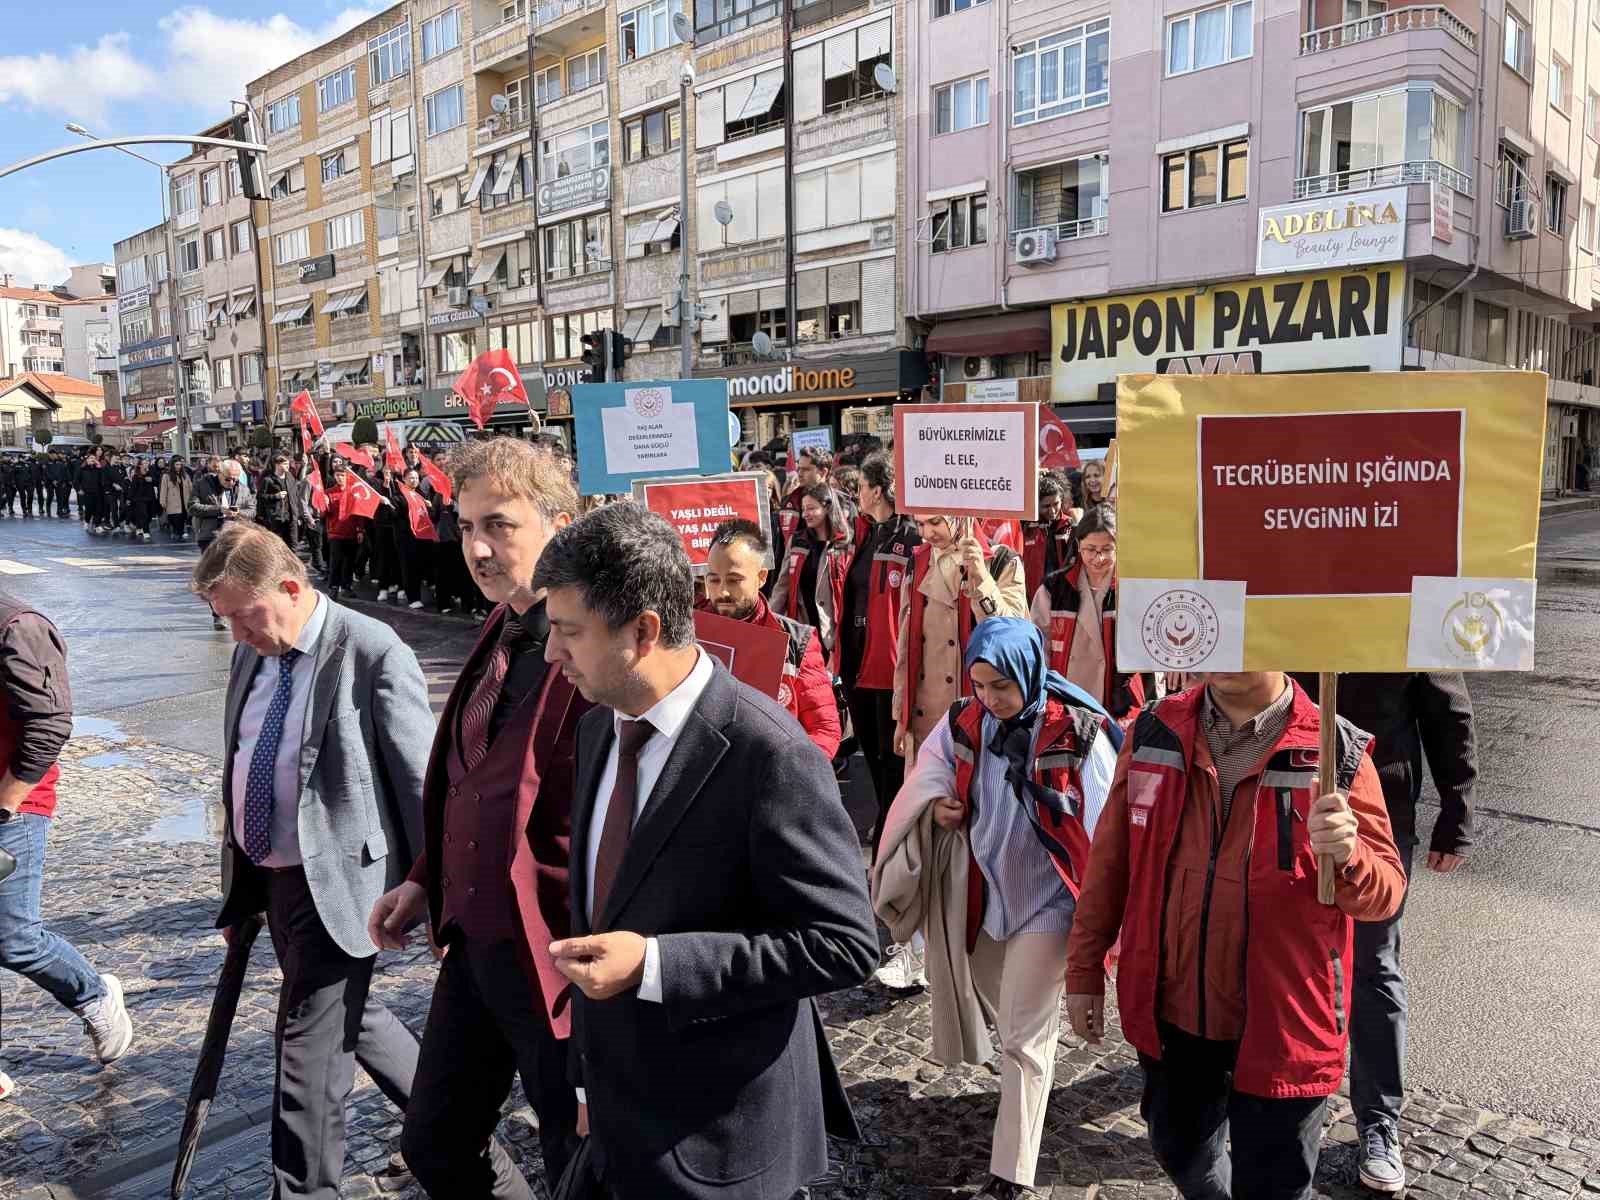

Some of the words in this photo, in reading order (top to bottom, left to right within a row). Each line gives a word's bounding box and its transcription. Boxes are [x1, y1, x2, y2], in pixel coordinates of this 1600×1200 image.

[1263, 200, 1399, 243] ADELİNA
[1294, 236, 1343, 258] Beauty
[1346, 231, 1397, 254] Lounge
[1060, 294, 1195, 363] JAPON
[1213, 271, 1391, 349] PAZARI
[918, 427, 1006, 441] BÜYÜKLERİMİZLE
[944, 454, 958, 465] EL
[958, 454, 978, 468] ELE,
[1212, 457, 1348, 486] TECRÜBENİN
[1355, 455, 1451, 487] IŞIĞINDA
[914, 475, 958, 489] DÜNDEN
[960, 476, 1012, 491] GELECEĞE
[670, 507, 702, 521] YAŞLI
[703, 504, 738, 517] DEĞİL,
[1374, 500, 1399, 528] İZİ
[677, 523, 699, 535] YAŞ
